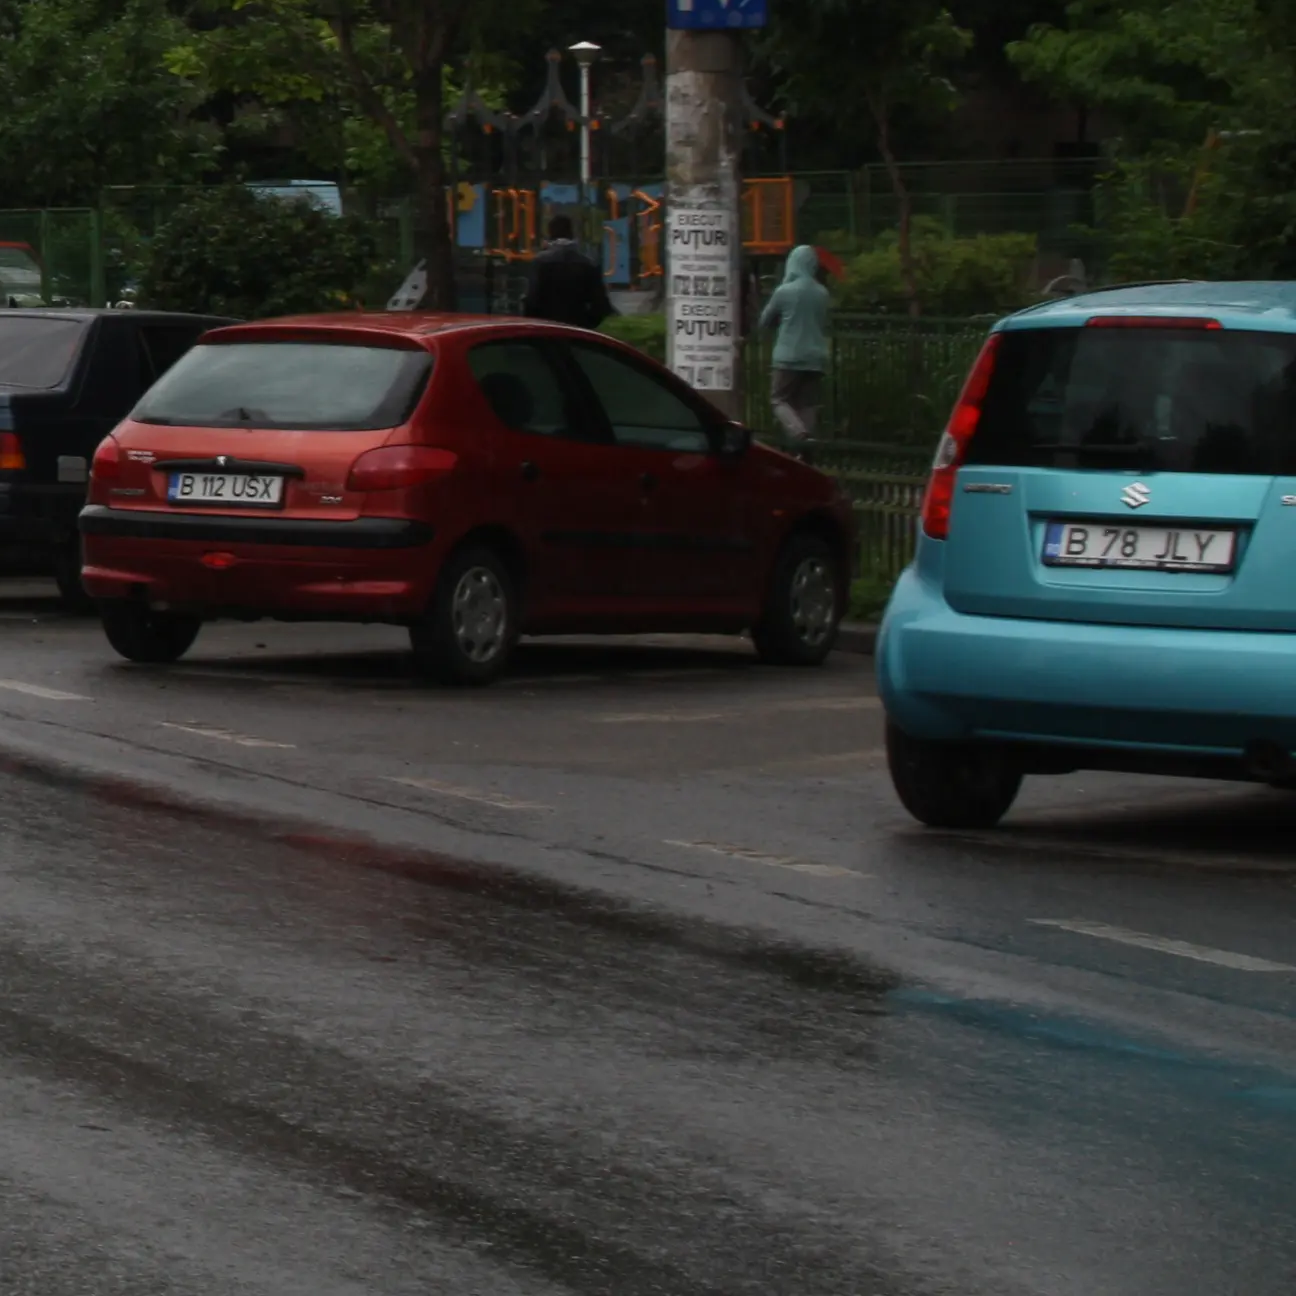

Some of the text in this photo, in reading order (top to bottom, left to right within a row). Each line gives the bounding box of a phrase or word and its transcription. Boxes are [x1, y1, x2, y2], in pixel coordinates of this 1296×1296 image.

[180, 475, 275, 500] B 112 USX
[1066, 527, 1089, 556] B
[1101, 529, 1138, 558] 78
[1155, 531, 1216, 561] JLY
